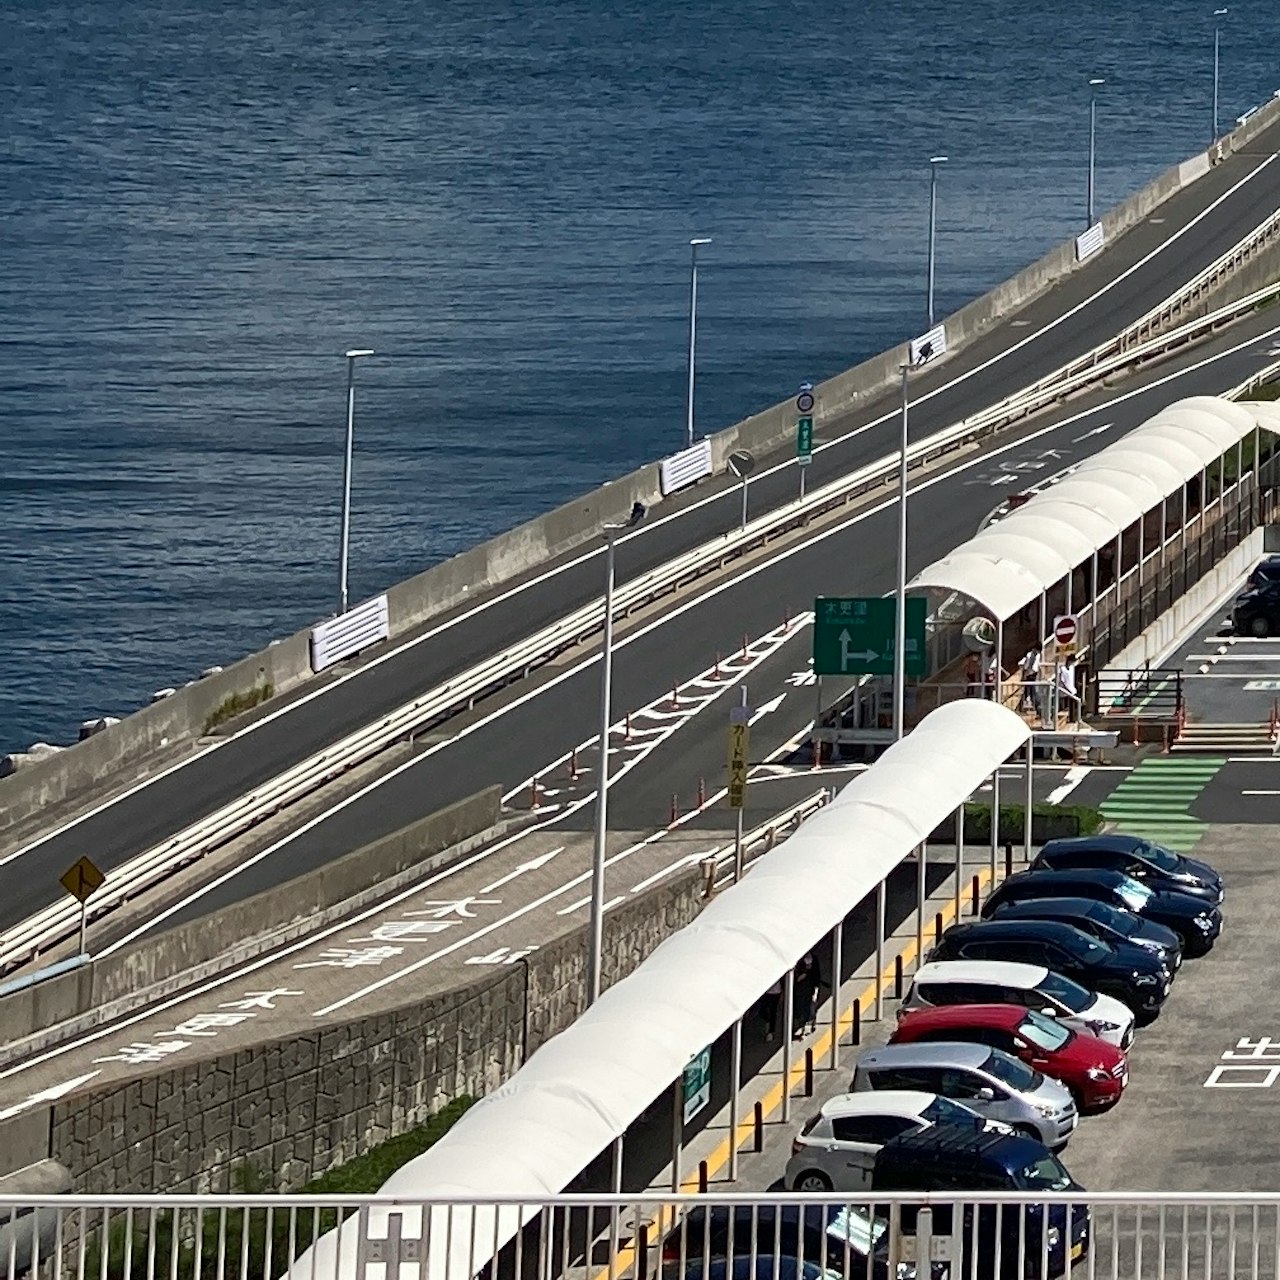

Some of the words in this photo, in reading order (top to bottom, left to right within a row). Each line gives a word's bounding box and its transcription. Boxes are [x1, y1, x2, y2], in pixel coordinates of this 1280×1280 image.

[293, 897, 502, 969] 木更津
[92, 988, 304, 1064] 木更津
